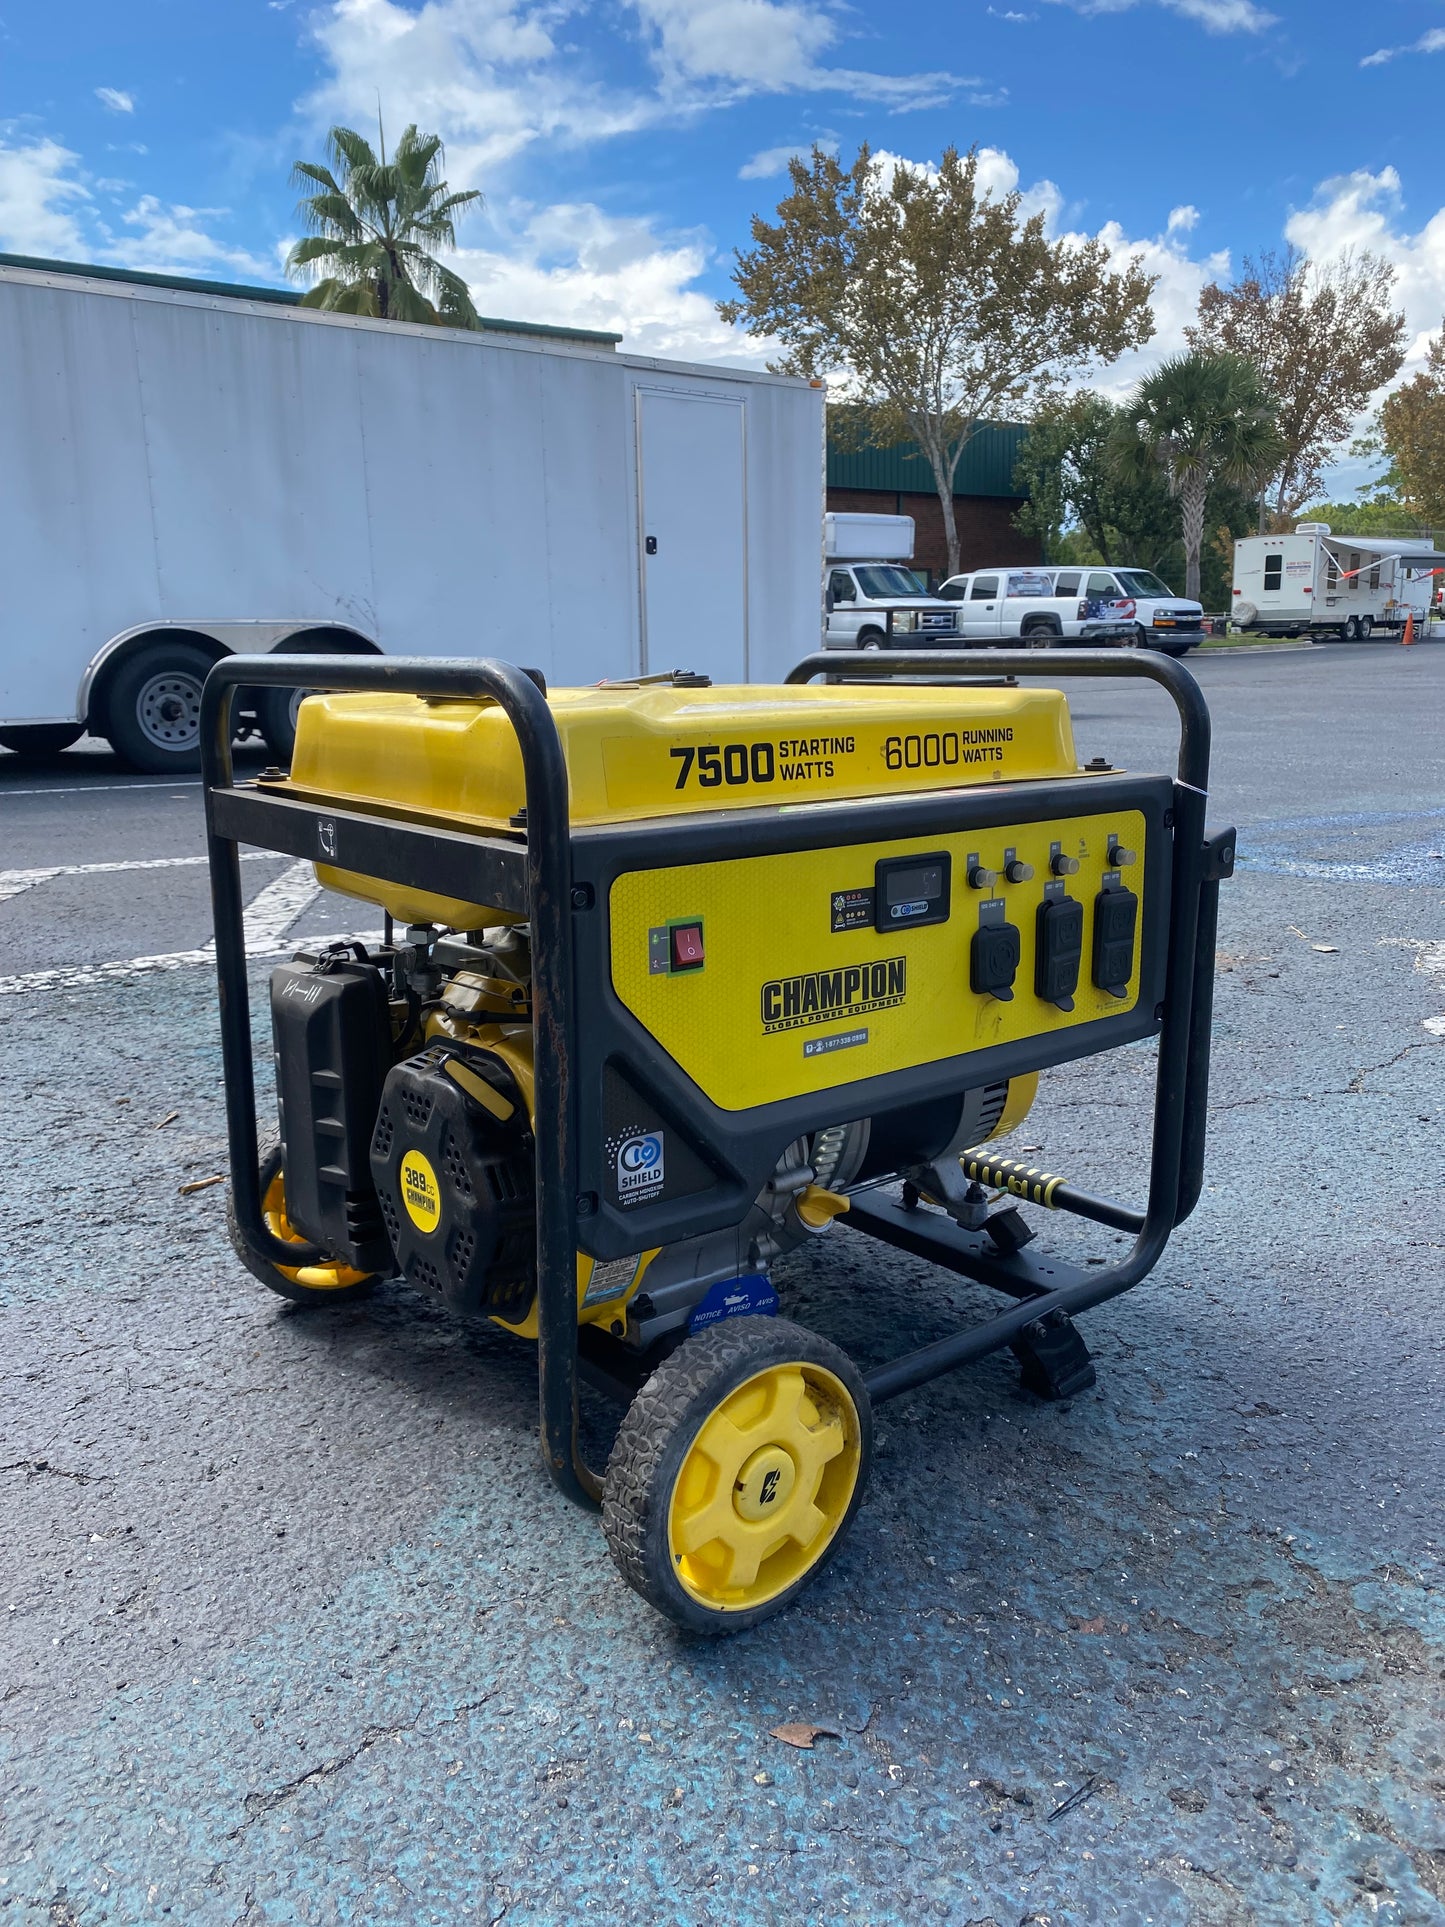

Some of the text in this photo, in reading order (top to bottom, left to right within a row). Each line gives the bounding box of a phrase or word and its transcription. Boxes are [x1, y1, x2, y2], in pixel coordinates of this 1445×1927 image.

[885, 727, 1013, 770] 6000 RUNNING
[962, 747, 1003, 763] WATTS
[669, 736, 855, 789] 7500 STARTING
[779, 761, 834, 781] WATTS
[762, 957, 905, 1023] CHAMPION
[765, 996, 904, 1032] GLOBAL POWER EQUIPMENT
[621, 1169, 661, 1188] SHIELD
[619, 1183, 664, 1201] CARBON MONOXIDE
[623, 1191, 660, 1206] AUTO-SHUTOFF
[694, 1296, 775, 1322] NOTICE AVISO AVIS
